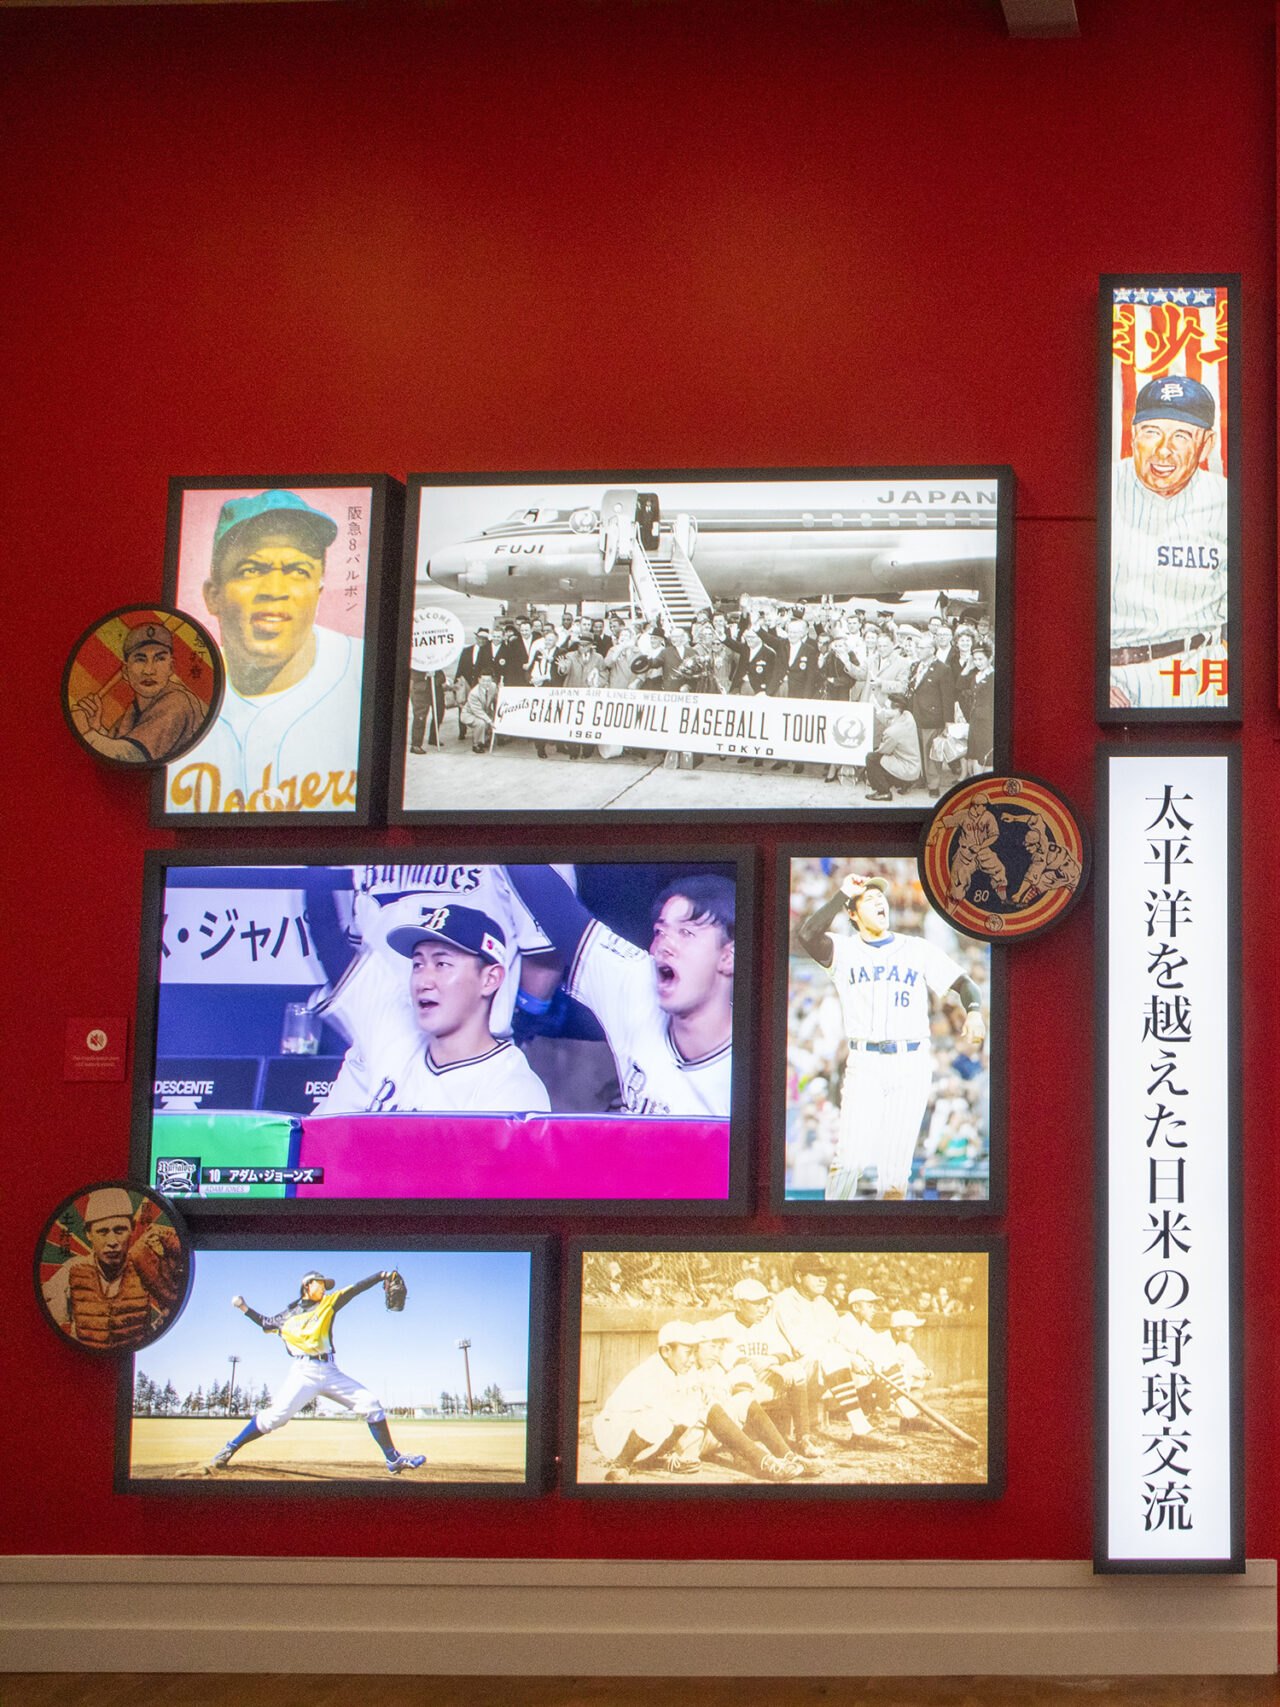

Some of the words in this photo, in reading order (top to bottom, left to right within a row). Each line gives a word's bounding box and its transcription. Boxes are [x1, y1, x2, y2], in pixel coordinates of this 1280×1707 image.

[876, 489, 997, 505] JAPAN
[494, 544, 544, 554] FUJI
[344, 505, 363, 612] 阪急8バルボン
[1157, 545, 1220, 570] SEALS
[412, 633, 455, 648] IANTS
[1158, 658, 1228, 697] 十月
[549, 688, 580, 697] JAPAN
[585, 689, 602, 698] AIR
[606, 690, 636, 700] LINES
[643, 693, 699, 704] WELCOMES
[529, 698, 585, 725] GIANTS
[592, 700, 669, 733] GOODWILL
[679, 706, 770, 741] BASEBALL
[782, 712, 827, 744] TOUR
[568, 730, 603, 740] 1960
[716, 743, 775, 756] TOKYO
[973, 889, 990, 902] 80
[848, 964, 919, 988] JAPAN
[894, 991, 911, 1008] 16
[154, 1080, 215, 1095] DESCENTE
[1140, 783, 1195, 1533] 太平洋を越えた日米の野球交流
[208, 1168, 221, 1183] 10
[228, 1168, 315, 1183] アダム・ジョーンズ
